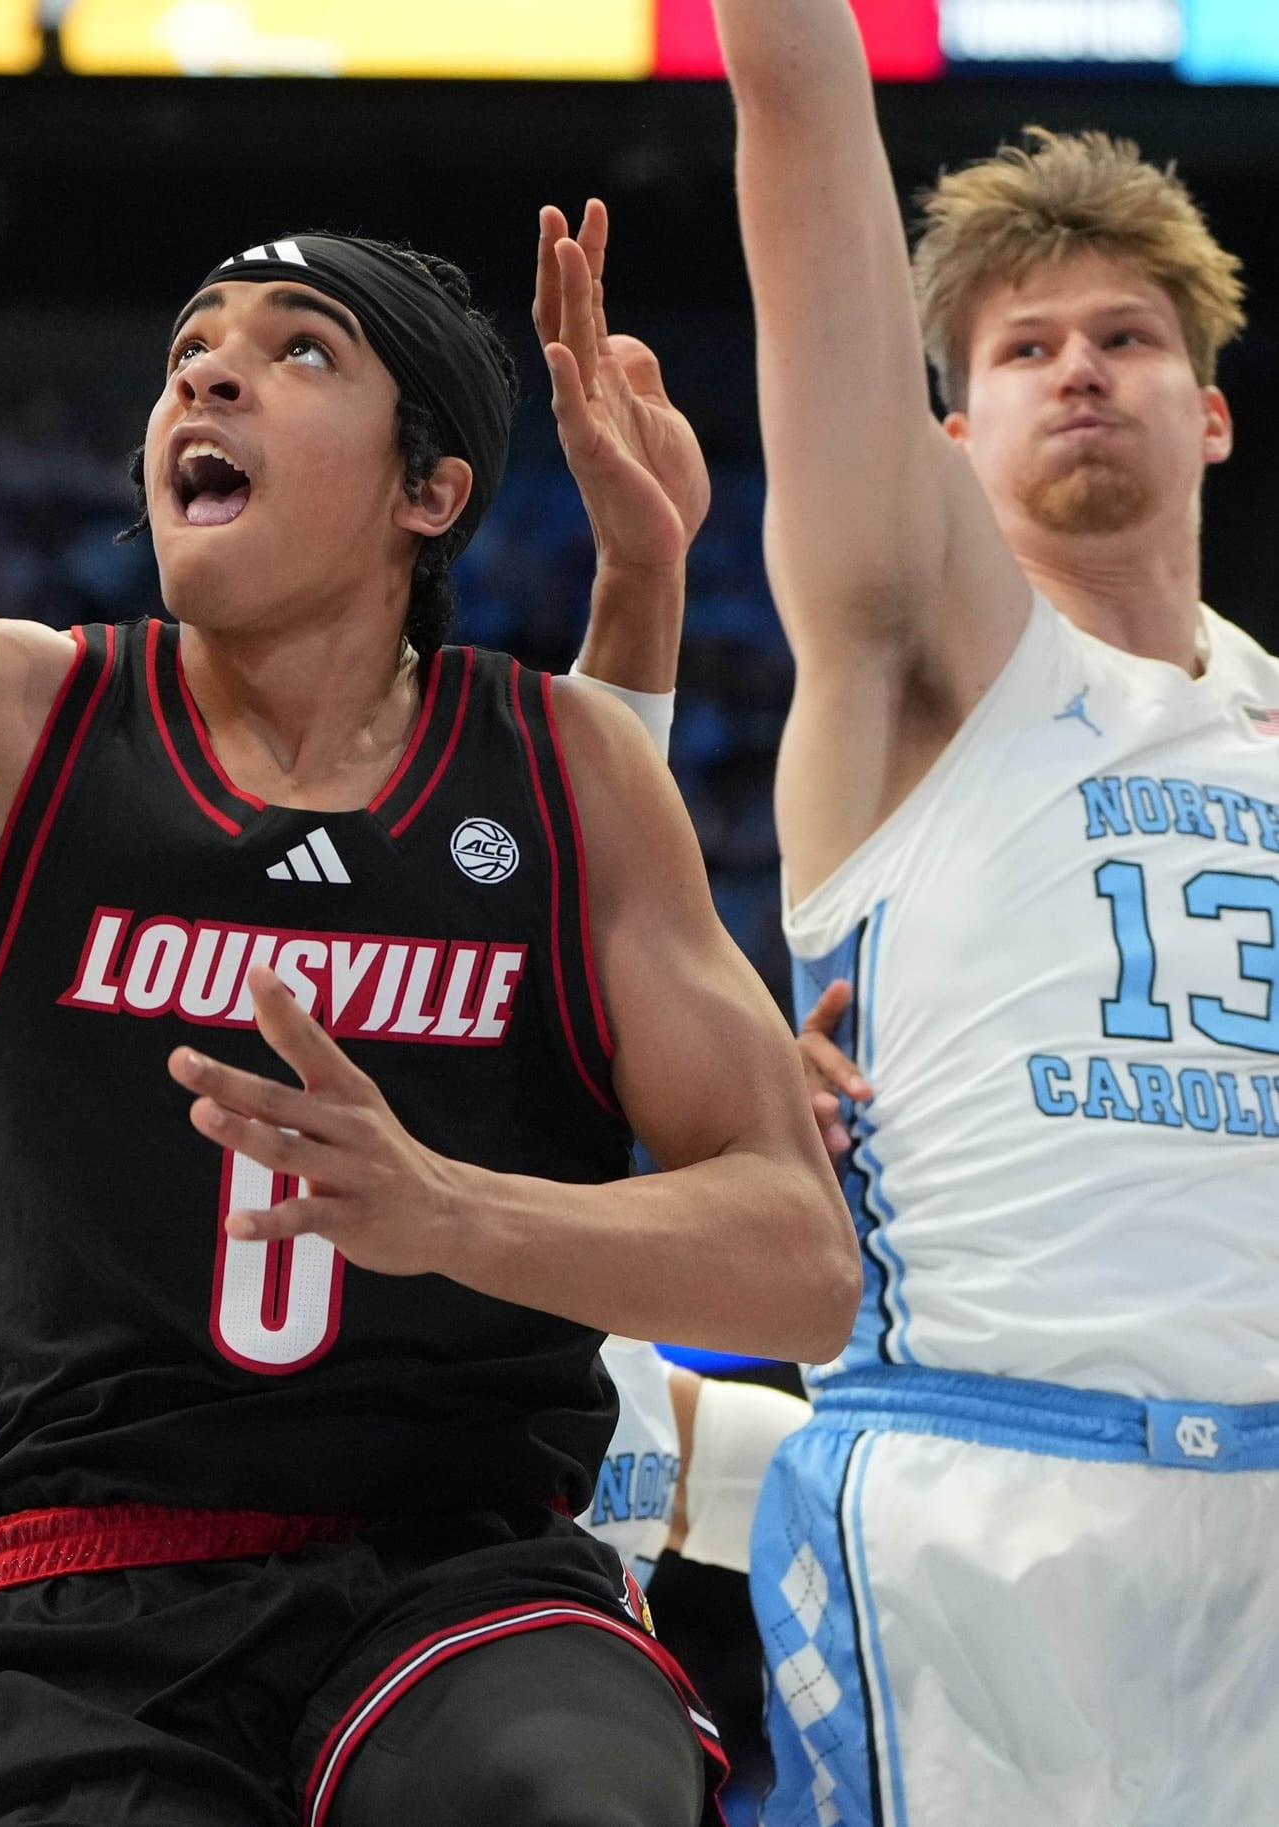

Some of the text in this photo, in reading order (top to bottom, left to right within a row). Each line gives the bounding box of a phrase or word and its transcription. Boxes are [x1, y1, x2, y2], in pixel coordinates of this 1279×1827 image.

[460, 839, 514, 858] ACC
[57, 906, 528, 1047] LOUISVILLE
[1094, 859, 1279, 1055] 13
[1028, 1054, 1279, 1138] CAROLI
